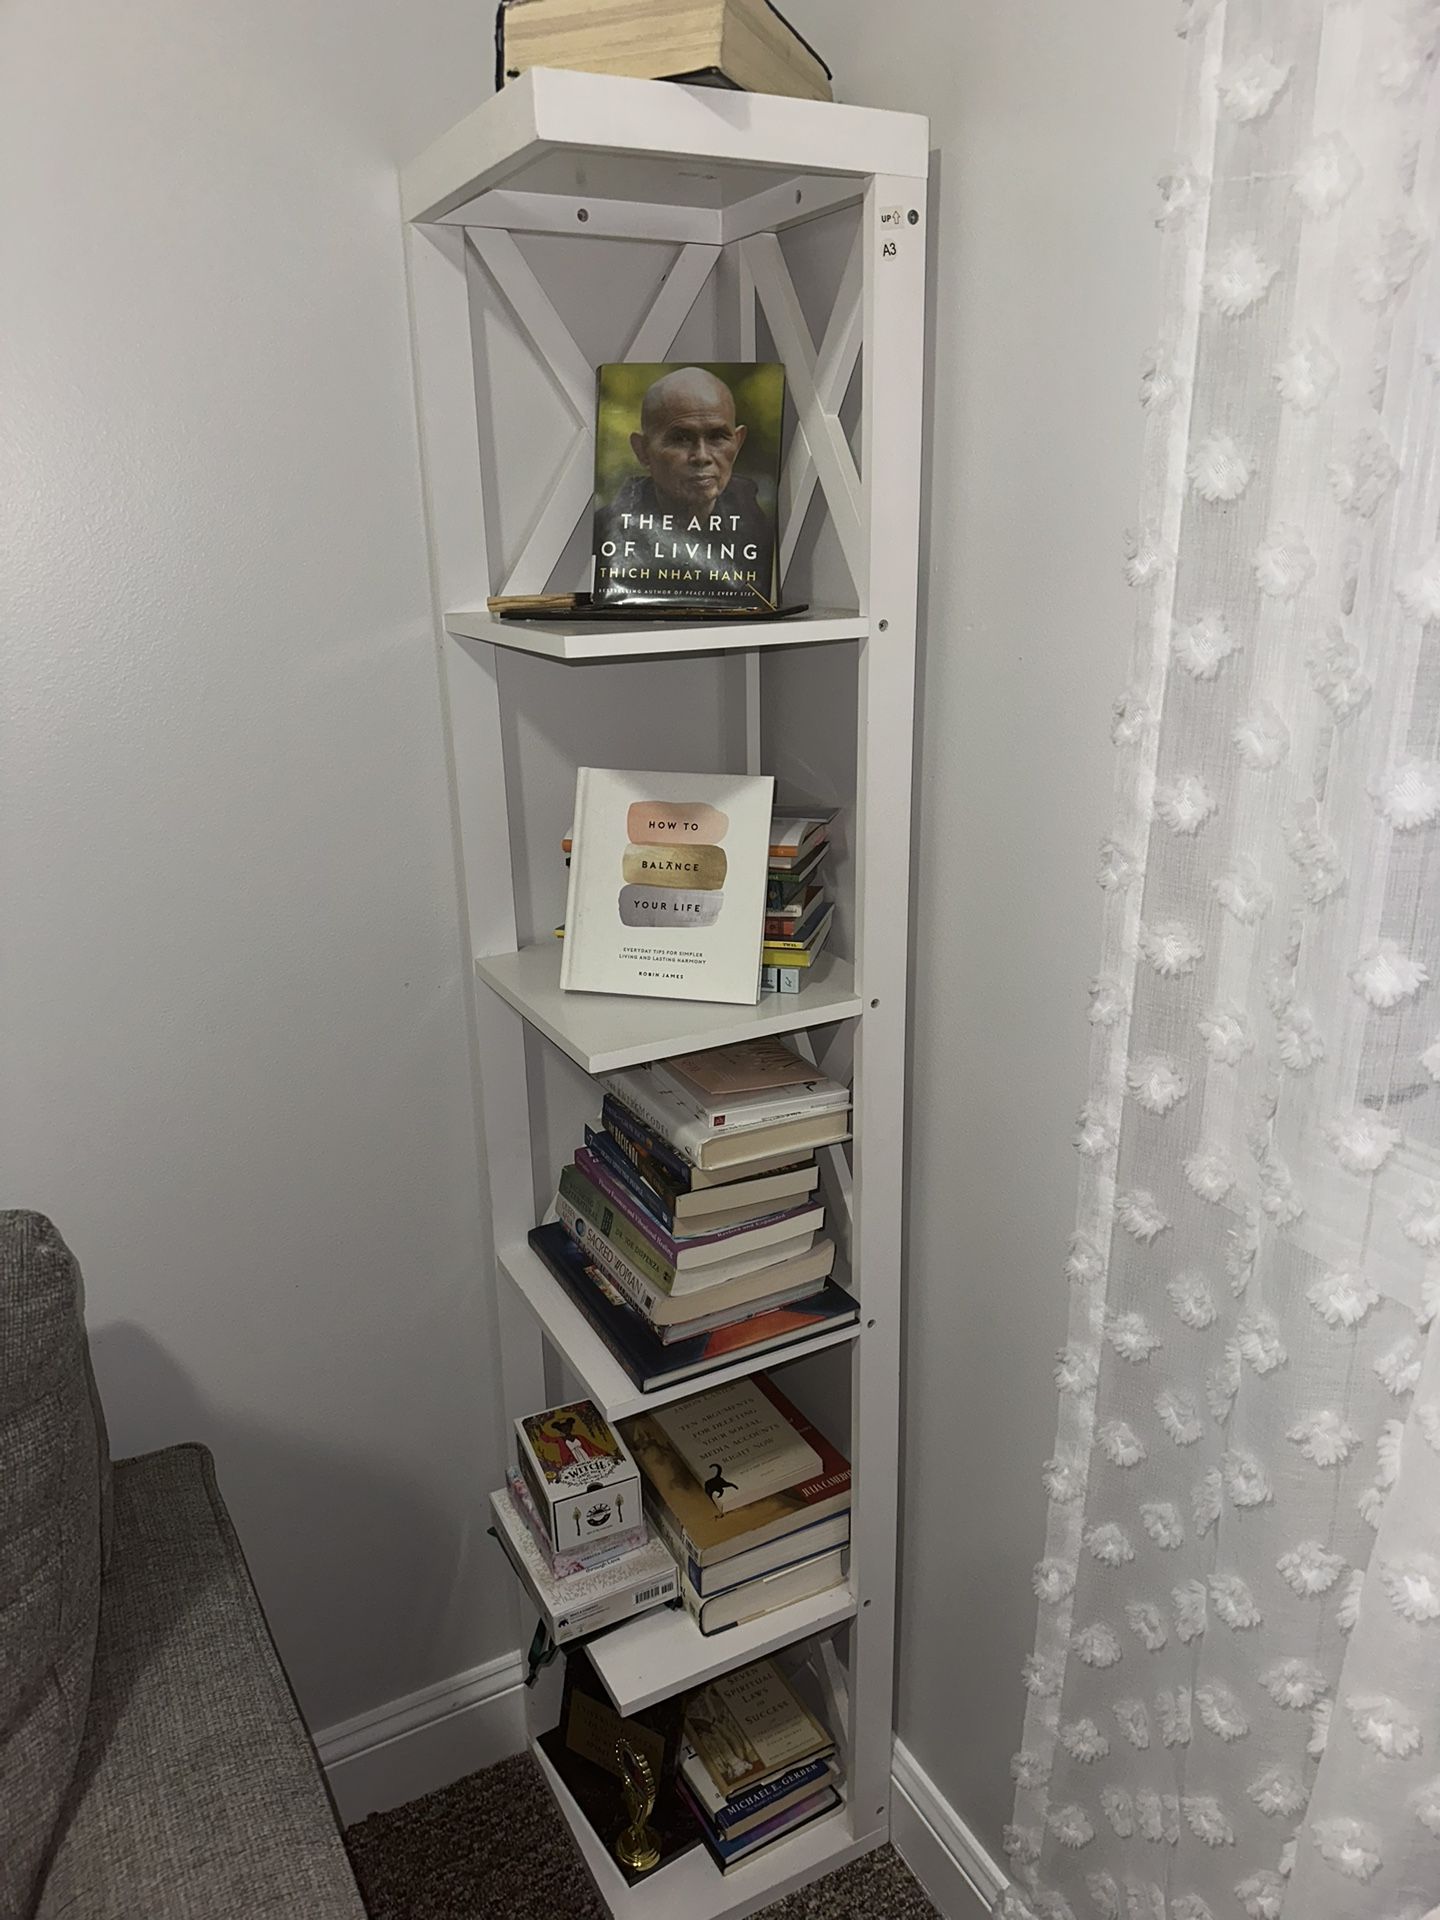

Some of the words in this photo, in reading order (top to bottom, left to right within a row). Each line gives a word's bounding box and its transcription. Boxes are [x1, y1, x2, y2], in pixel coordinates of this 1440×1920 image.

[881, 214, 891, 223] UP
[882, 242, 897, 257] A3
[621, 513, 674, 531] THE
[687, 515, 741, 532] ART
[601, 541, 636, 558] OF
[654, 542, 758, 560] LIVING
[600, 567, 650, 579] THICH
[658, 568, 702, 581] NHAT
[709, 569, 757, 582] HANH
[648, 821, 677, 830] HOW
[683, 822, 699, 831] TO
[641, 860, 700, 872] BALANCE
[633, 900, 667, 911] YOUR
[673, 903, 701, 913] LIFE
[623, 946, 652, 954] EVERYDAY
[677, 957, 707, 965] HARMONY
[743, 1222, 754, 1230] and
[586, 1228, 614, 1263] SACRED
[614, 1258, 644, 1294] WOMAN
[678, 1421, 698, 1432] TEN
[702, 1397, 755, 1422] ARGUMENTS
[692, 1427, 711, 1439] FOR
[711, 1408, 758, 1431] DELETING
[701, 1432, 728, 1447] YOUR
[728, 1418, 762, 1435] SOCIAL
[698, 1443, 730, 1461] MEDIA
[732, 1423, 780, 1446] ACCOUNTS
[568, 1461, 607, 1479] WITCH
[801, 1482, 824, 1497] JULIA
[821, 1469, 851, 1489] CAMERO
[723, 1672, 773, 1698] SPIRITUAL
[727, 1668, 759, 1685] SEVEN
[741, 1687, 769, 1704] LAWS
[744, 1700, 790, 1725] SUCCESS
[727, 1788, 772, 1817] MICHAEL
[781, 1763, 818, 1786] GERBER
